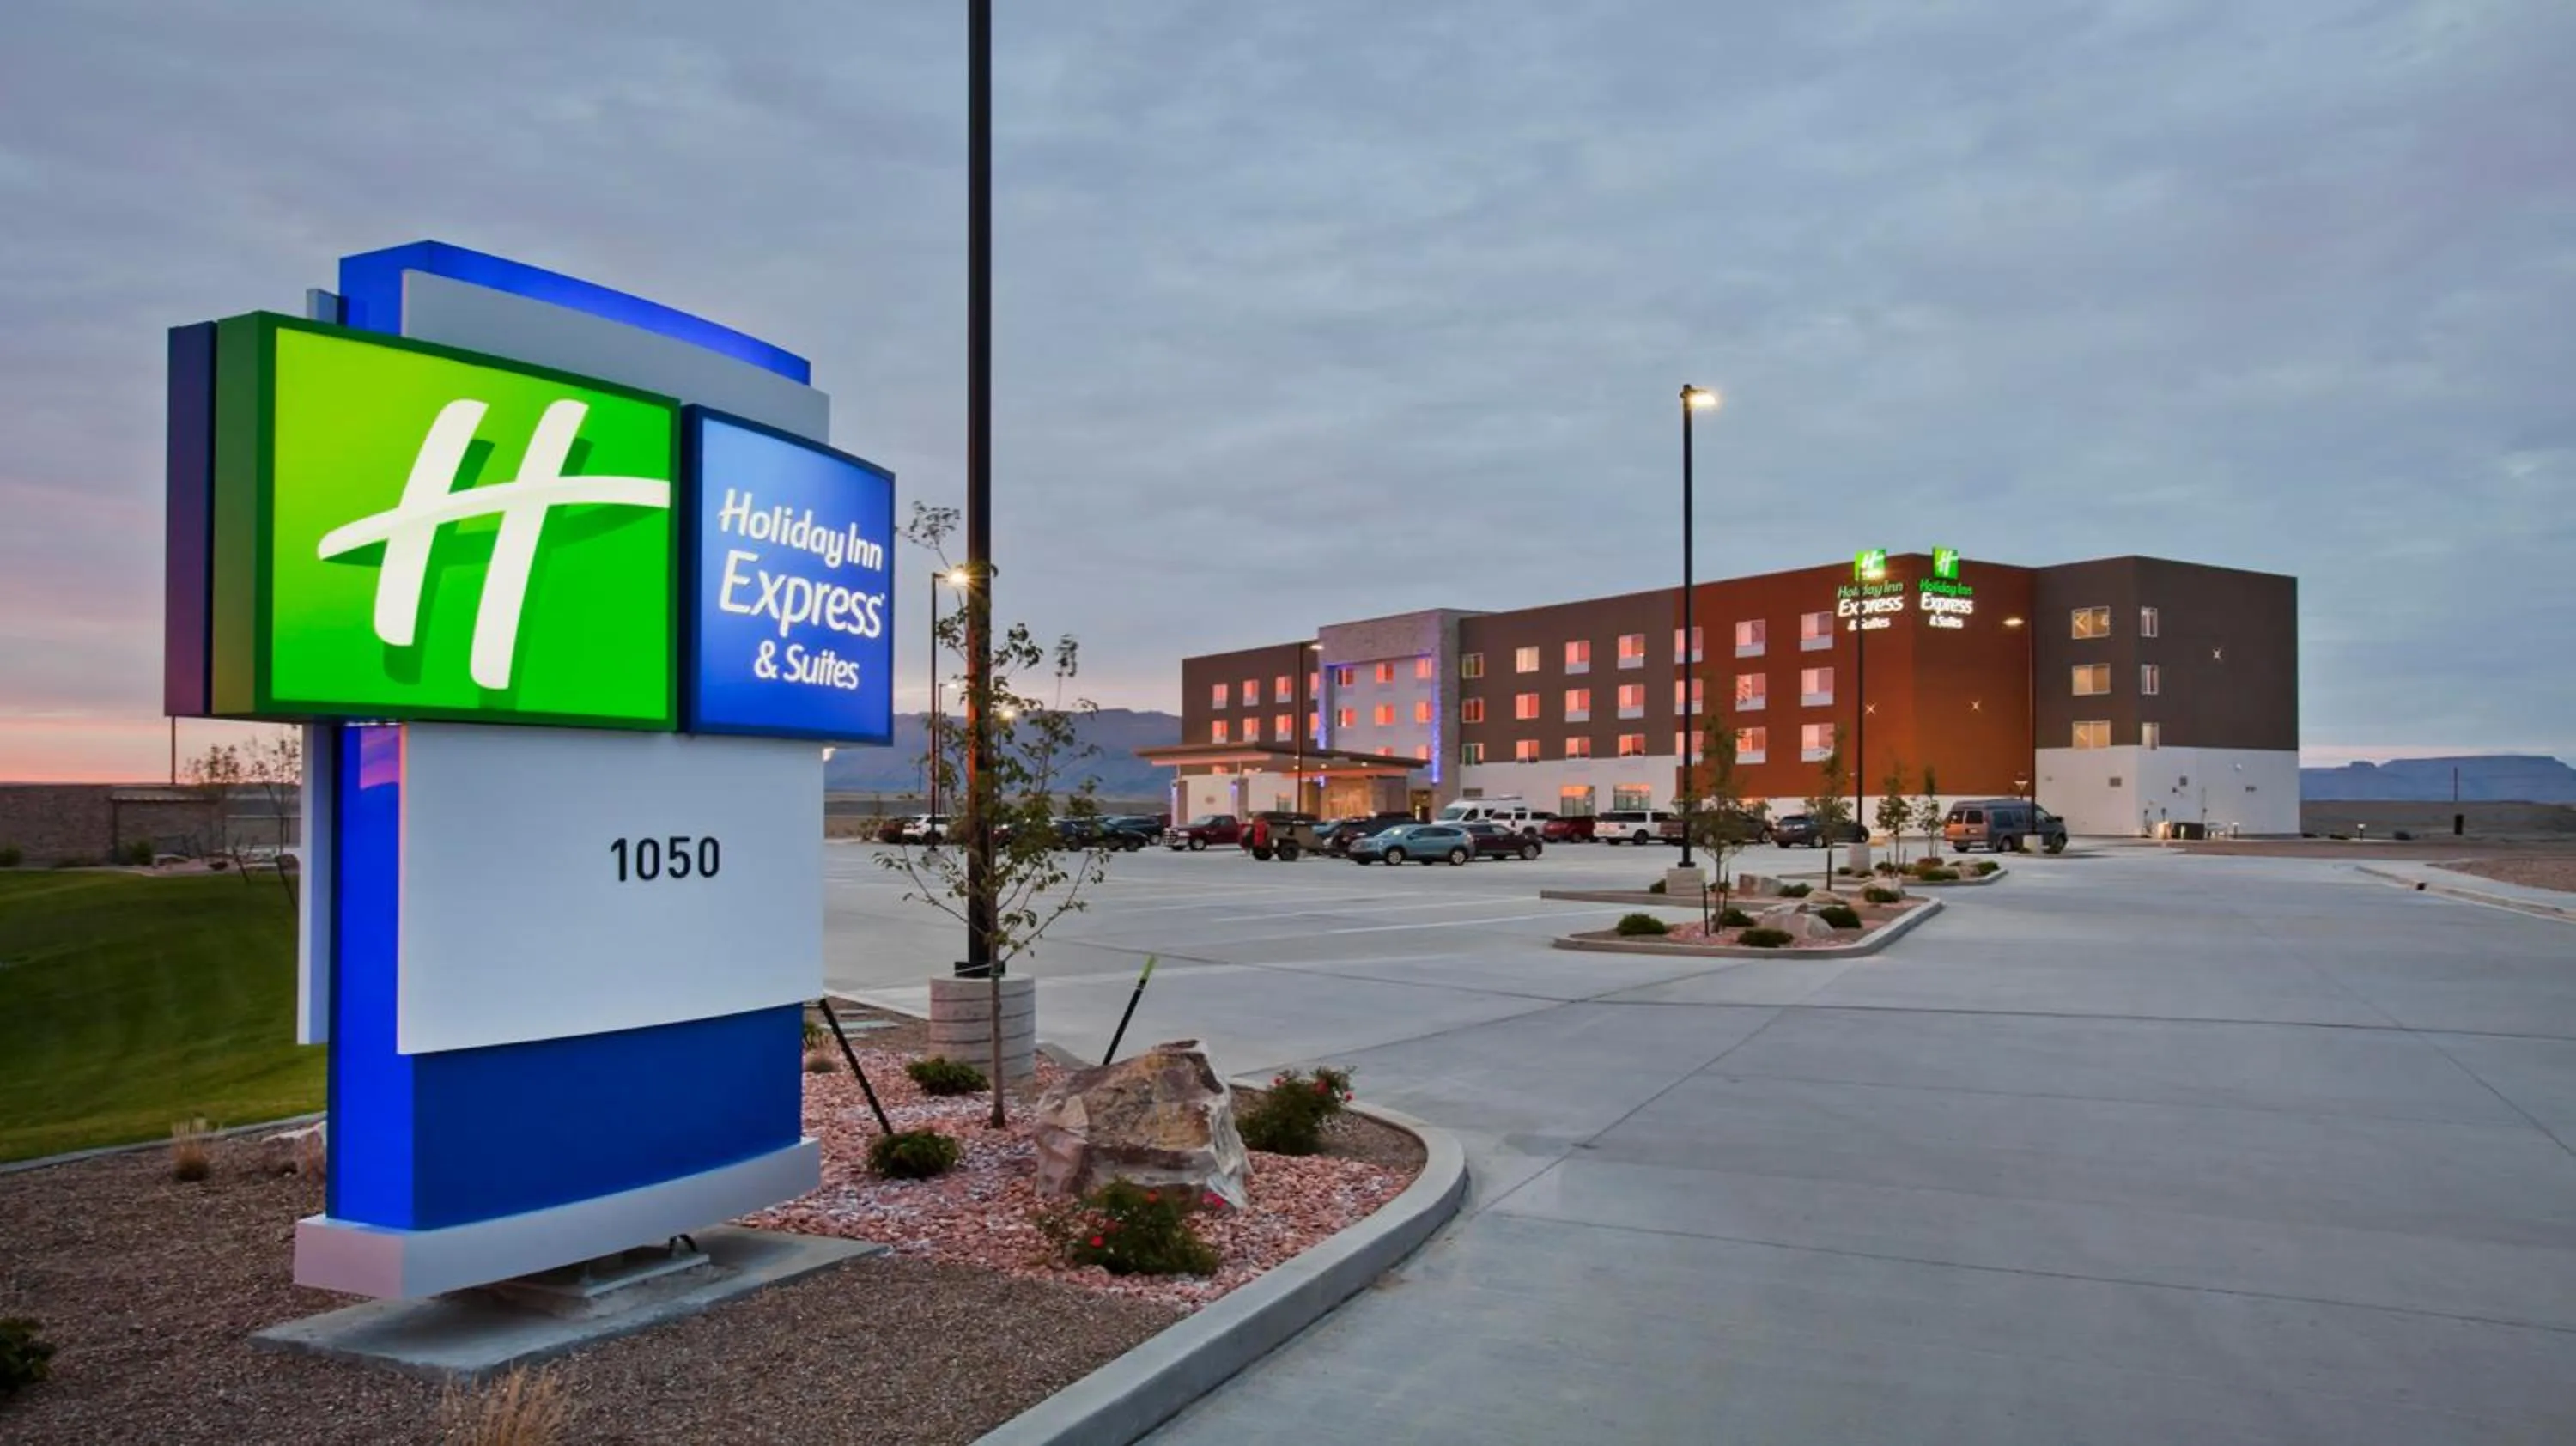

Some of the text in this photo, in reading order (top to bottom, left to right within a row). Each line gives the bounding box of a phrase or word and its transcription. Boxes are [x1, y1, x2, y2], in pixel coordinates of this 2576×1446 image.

[317, 398, 671, 690] H
[719, 488, 883, 571] Holiday Inn
[719, 549, 883, 638] Express
[1838, 584, 1883, 598] Holday
[1920, 578, 1957, 597] Holiday
[1921, 592, 1974, 615] Express
[1938, 615, 1964, 629] Suites
[754, 640, 860, 690] & Suites
[611, 836, 720, 882] 1050
